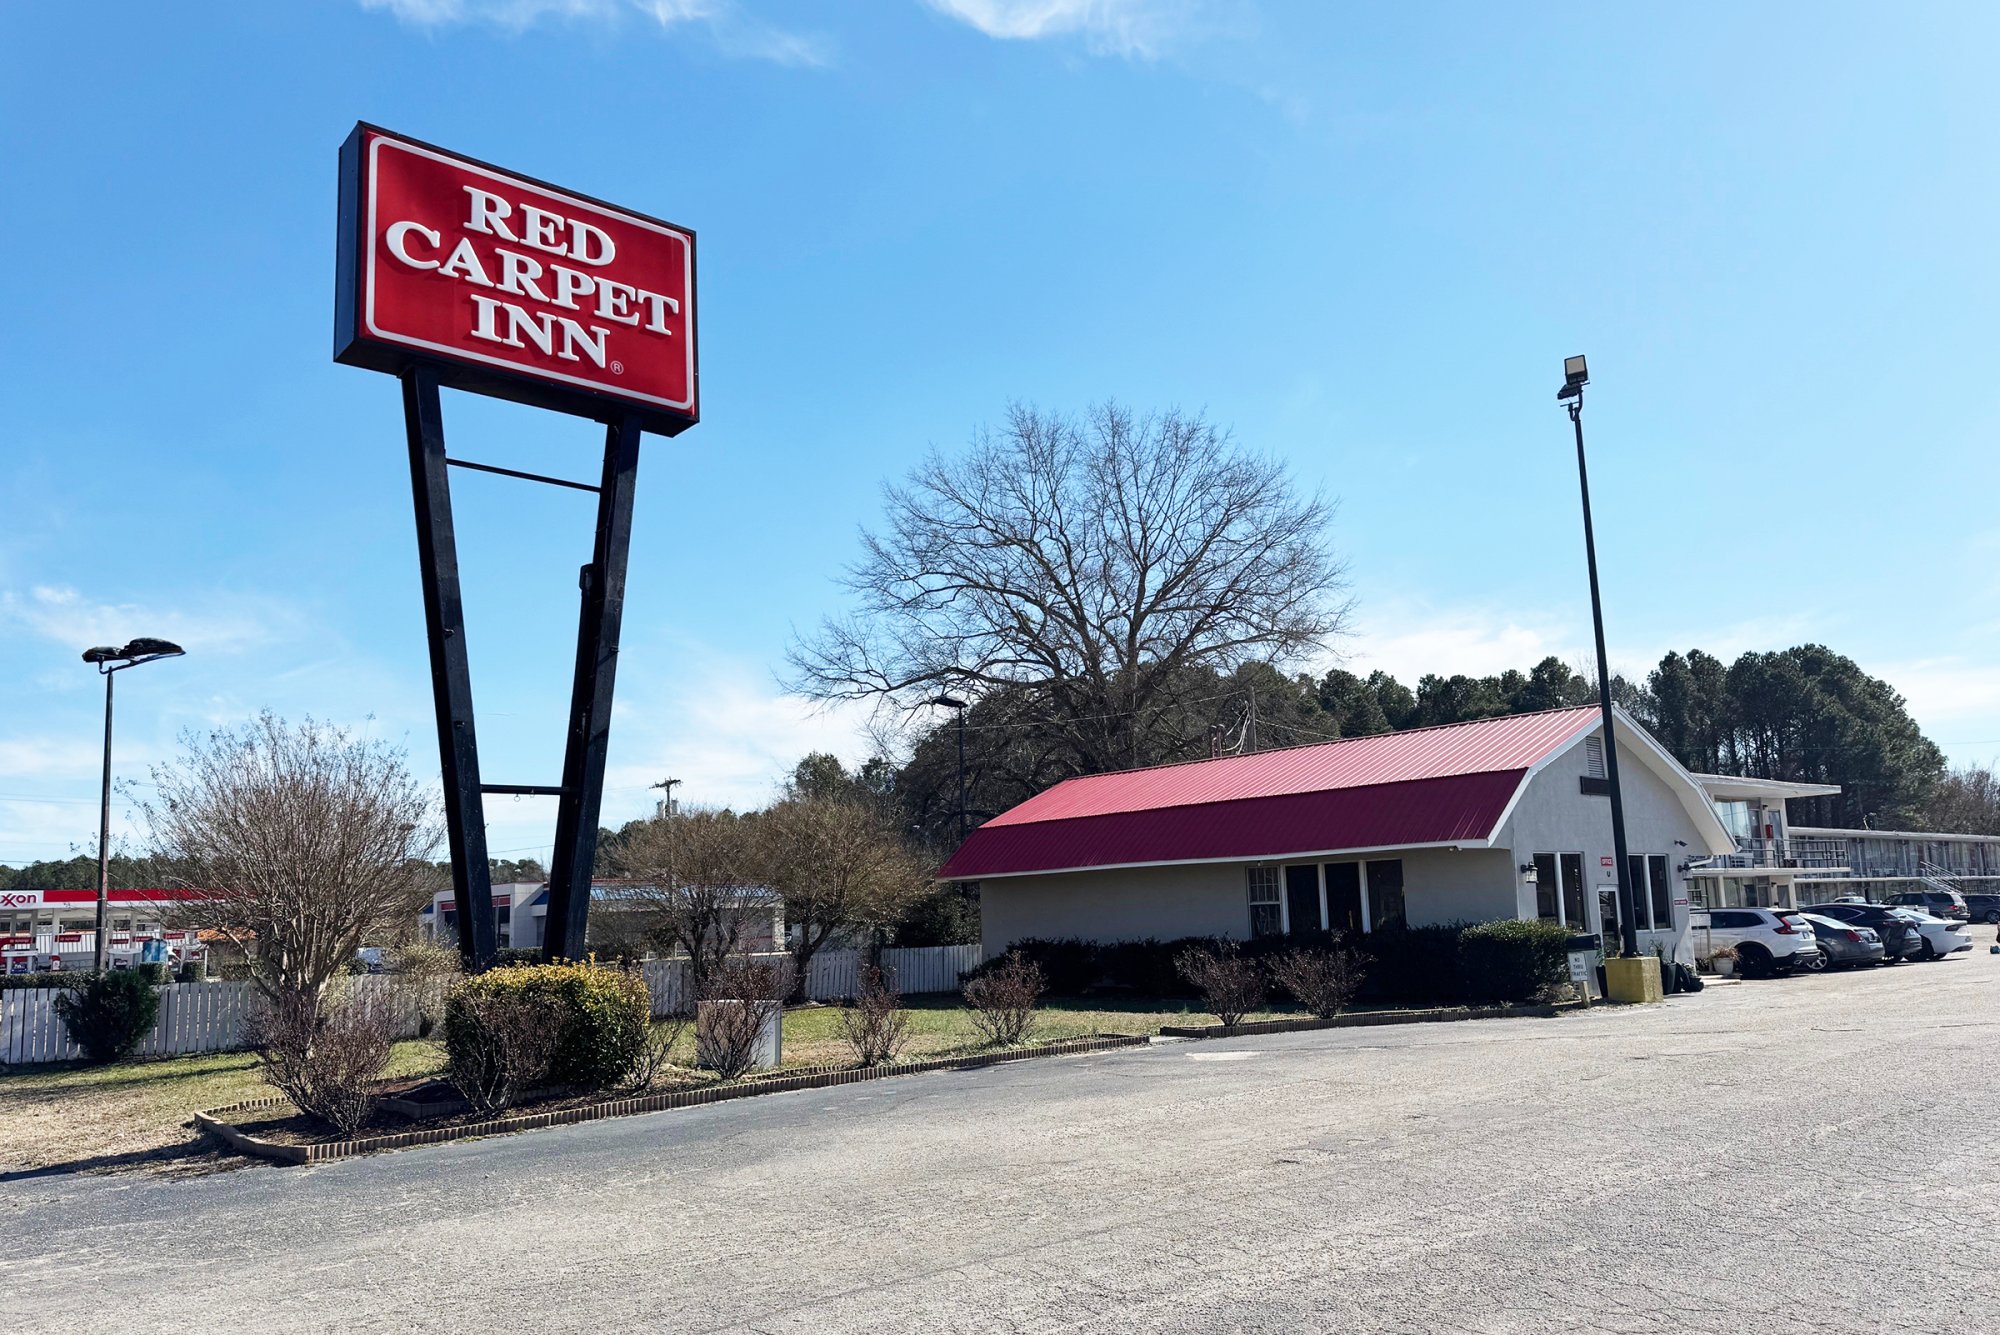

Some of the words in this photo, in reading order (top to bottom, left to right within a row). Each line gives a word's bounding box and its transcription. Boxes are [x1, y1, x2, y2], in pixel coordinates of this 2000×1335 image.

[463, 185, 616, 266] RED
[386, 221, 679, 336] CARPET
[471, 294, 610, 368] INN
